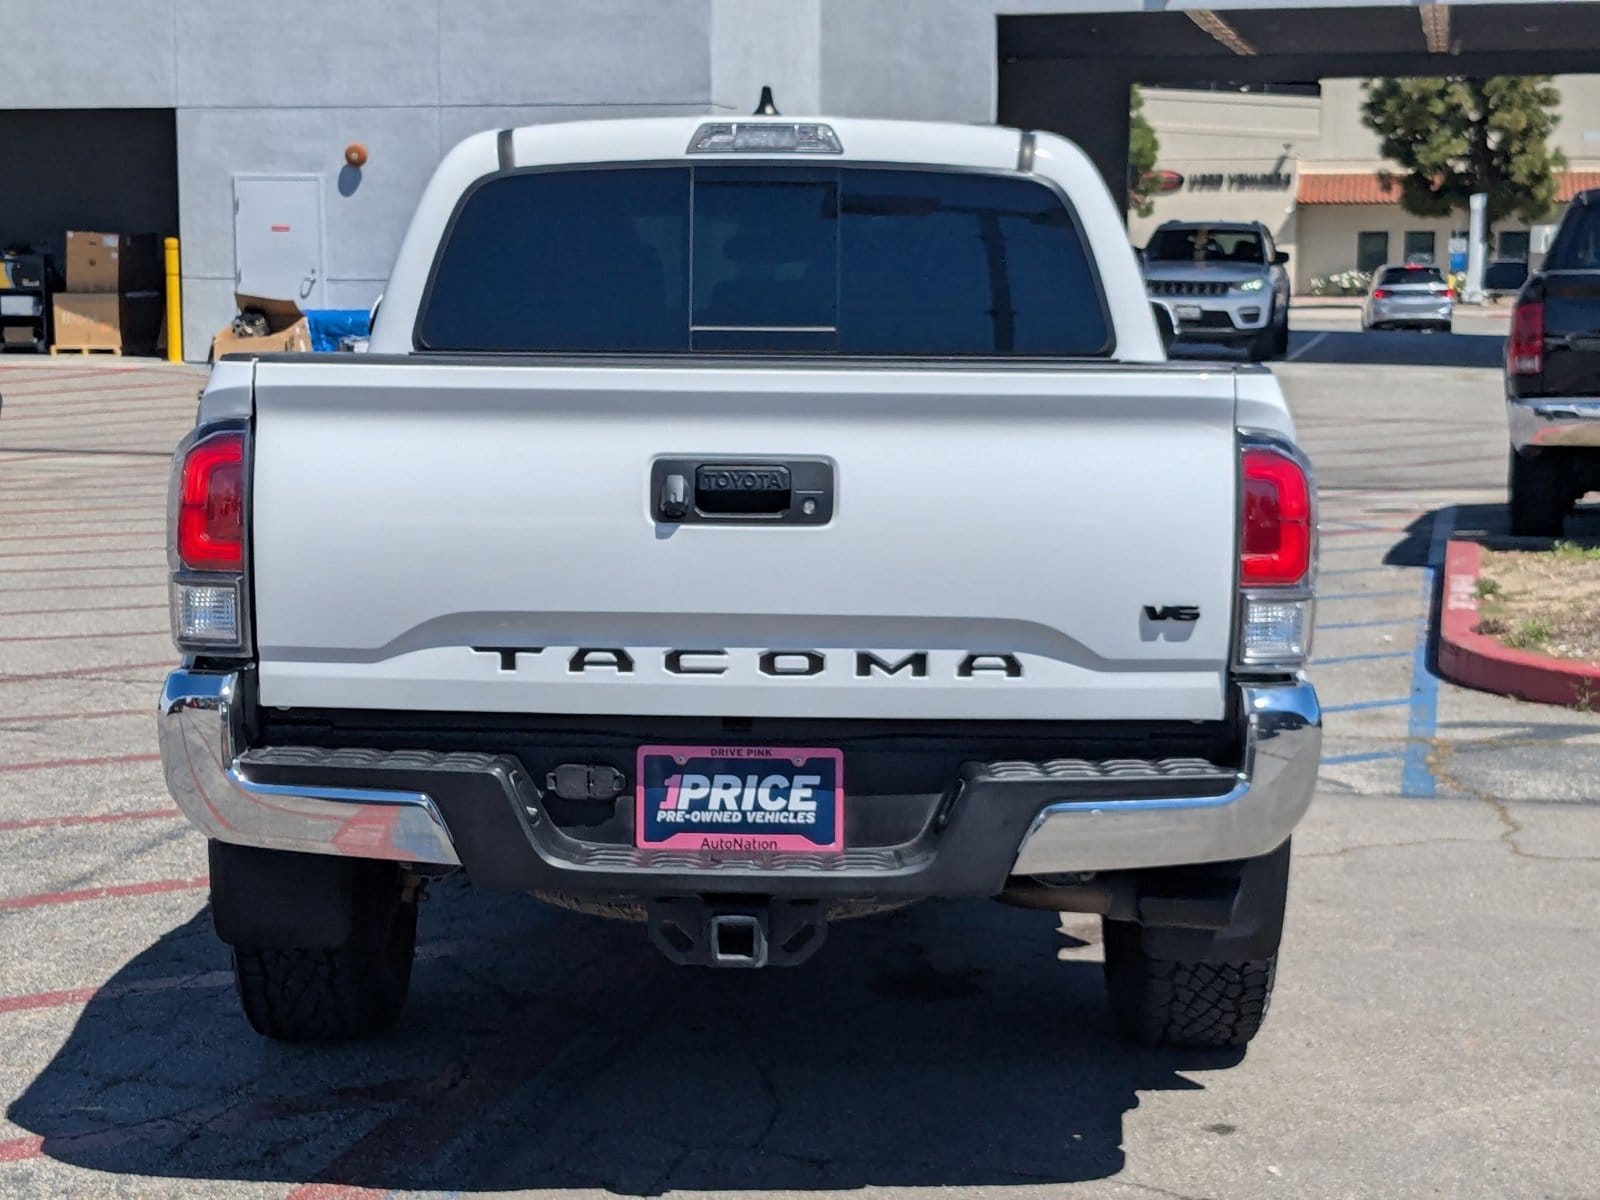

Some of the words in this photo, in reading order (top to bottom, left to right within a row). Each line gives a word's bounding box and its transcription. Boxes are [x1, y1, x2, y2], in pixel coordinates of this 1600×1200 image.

[704, 472, 783, 489] TOYOTA
[1143, 605, 1200, 621] V6
[471, 645, 1022, 677] TACOMA
[710, 748, 743, 757] DRIVE
[746, 748, 772, 758] PINK
[656, 810, 742, 823] PRE-OWNED
[746, 811, 816, 824] VEHICLES
[701, 837, 778, 850] AutoNation
